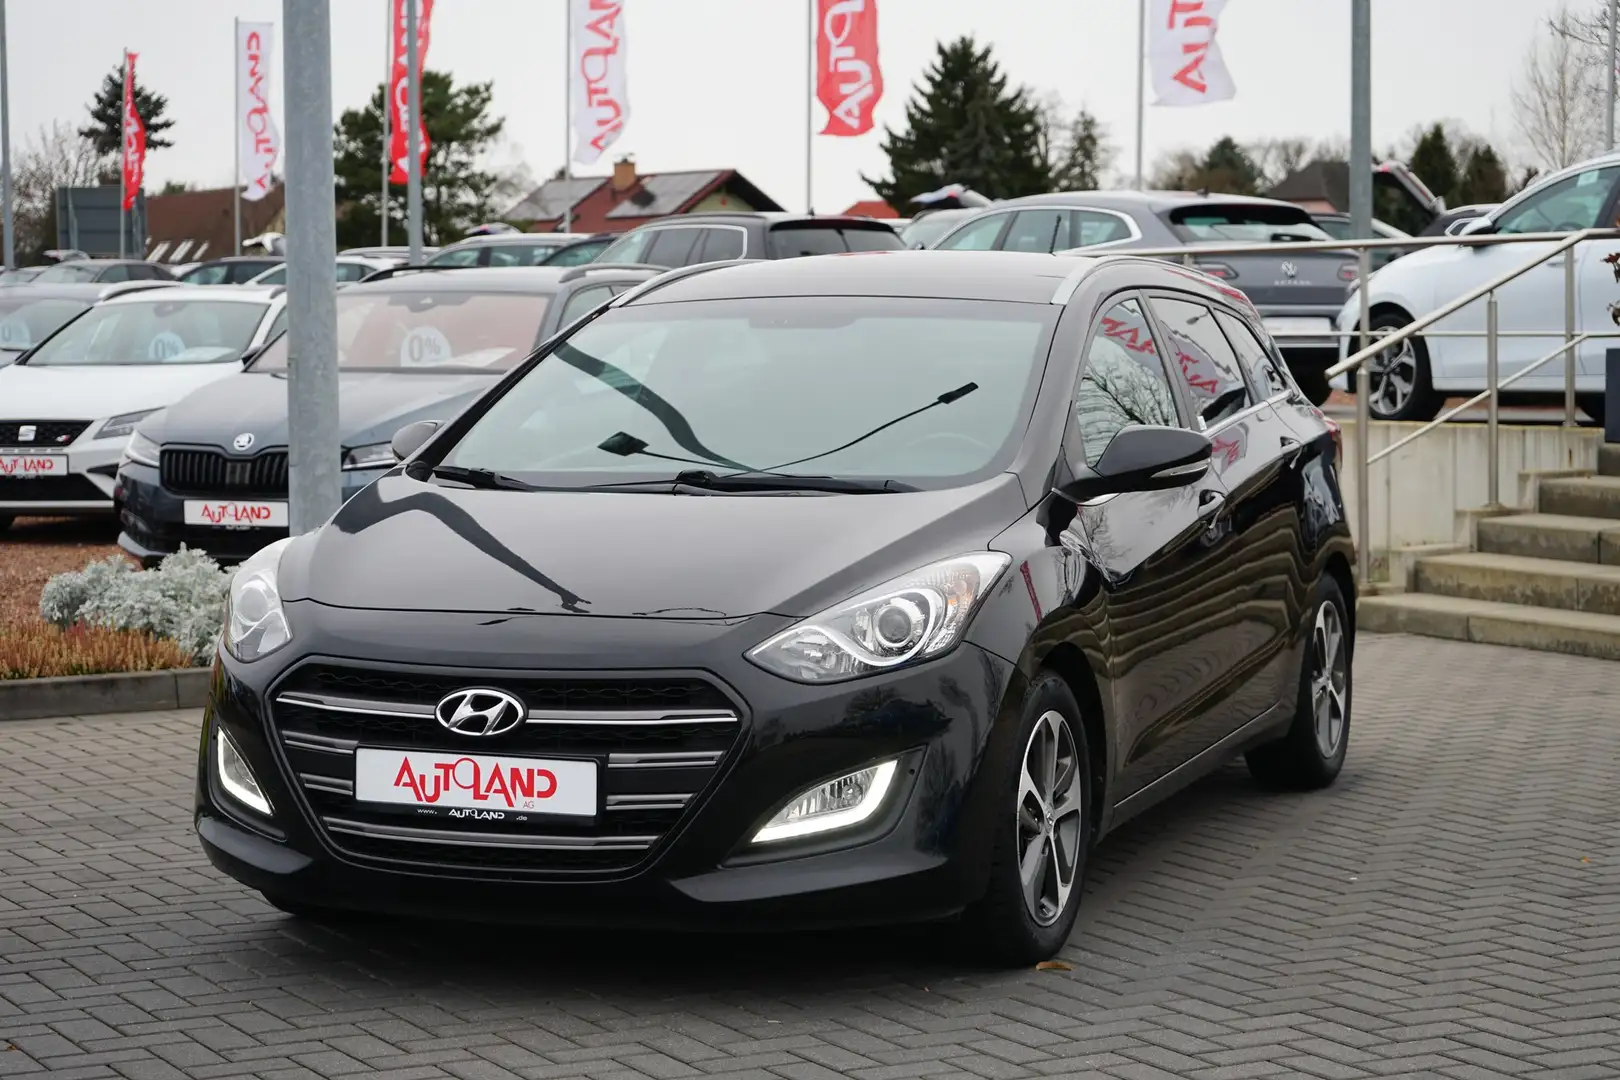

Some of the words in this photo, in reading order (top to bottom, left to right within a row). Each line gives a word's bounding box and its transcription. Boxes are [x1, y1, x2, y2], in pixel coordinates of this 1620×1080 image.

[408, 334, 441, 362] 0%
[201, 502, 271, 524] AUTOLAND
[394, 756, 558, 808] AUTOLAND
[449, 808, 505, 821] AUTOLAND
[522, 800, 535, 809] AG
